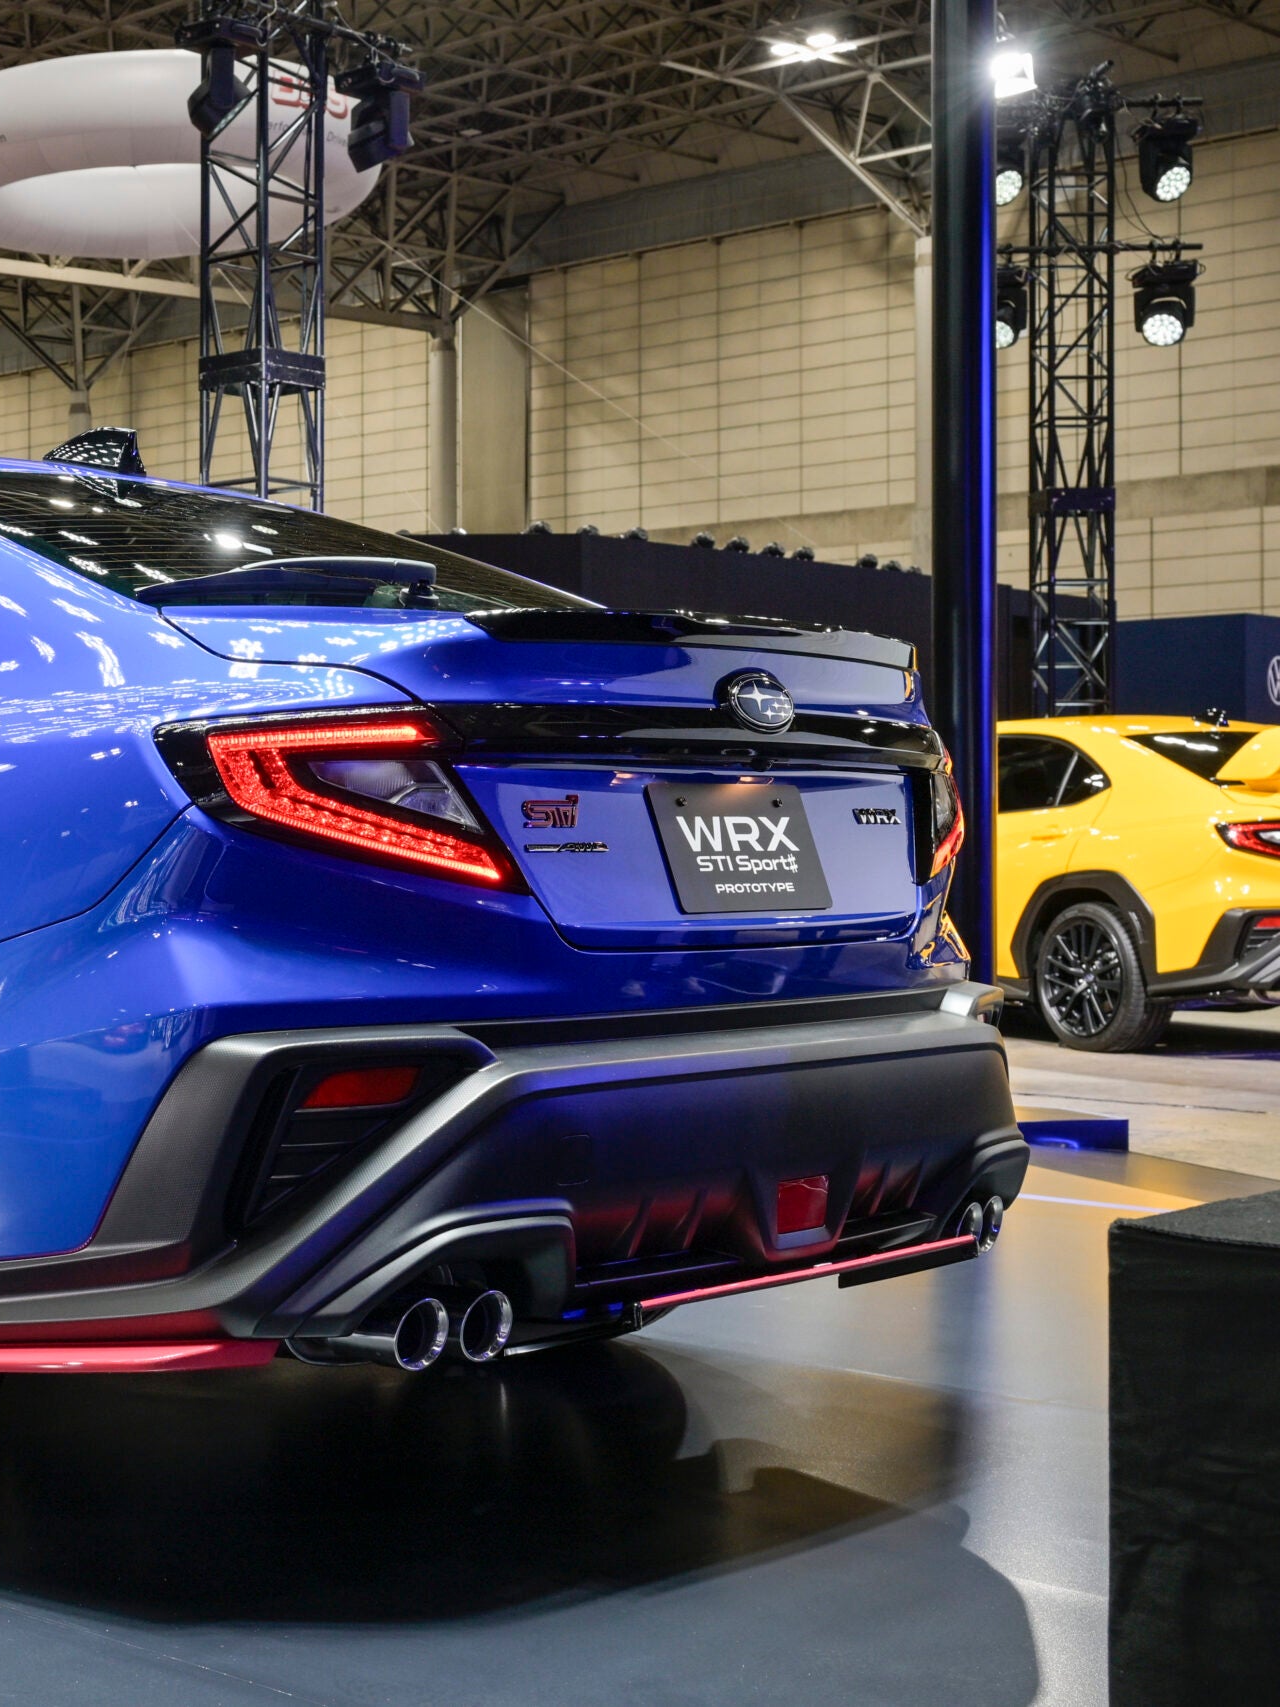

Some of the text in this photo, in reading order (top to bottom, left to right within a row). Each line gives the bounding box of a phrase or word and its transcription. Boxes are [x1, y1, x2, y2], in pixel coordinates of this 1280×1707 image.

[852, 808, 902, 825] WRX
[675, 816, 800, 852] WRX
[696, 853, 799, 875] STI Sport#
[715, 882, 796, 894] PROTOTYPE
